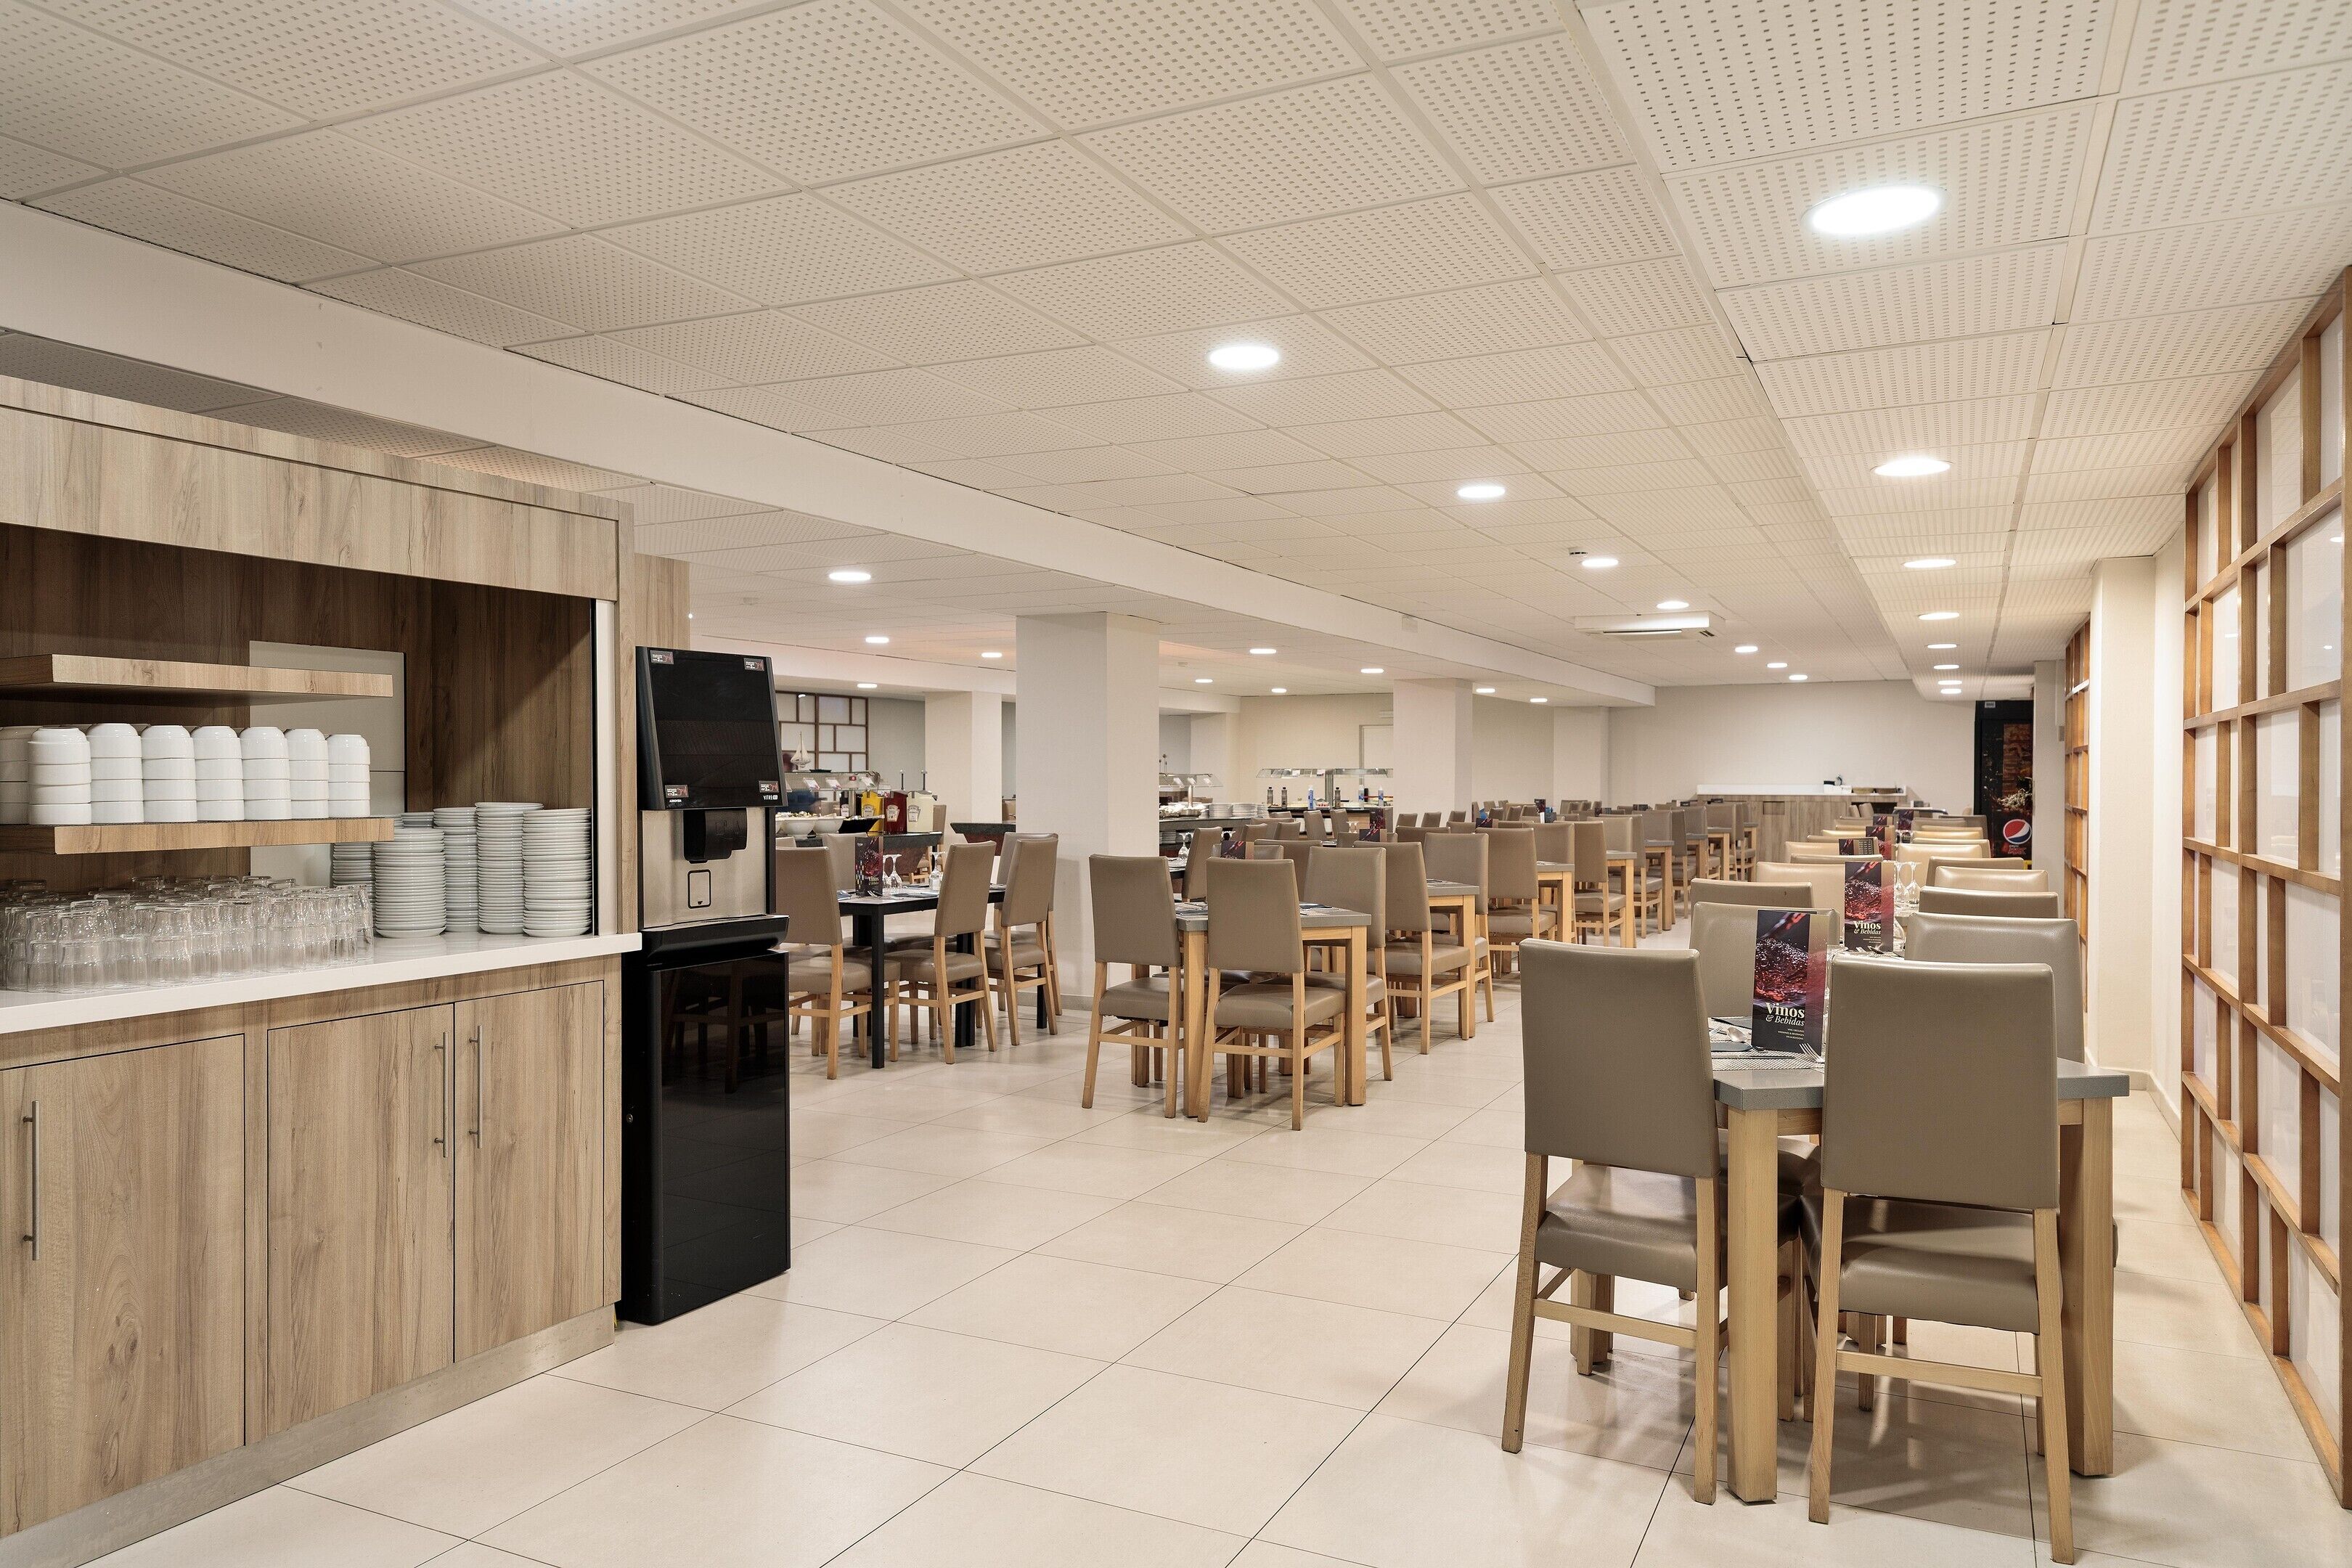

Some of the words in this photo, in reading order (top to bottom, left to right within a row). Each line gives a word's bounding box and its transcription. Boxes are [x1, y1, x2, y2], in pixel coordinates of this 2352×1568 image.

[1853, 920, 1881, 930] Vinos
[1765, 1002, 1805, 1018] Vinos
[1774, 1015, 1805, 1026] Bebidas
